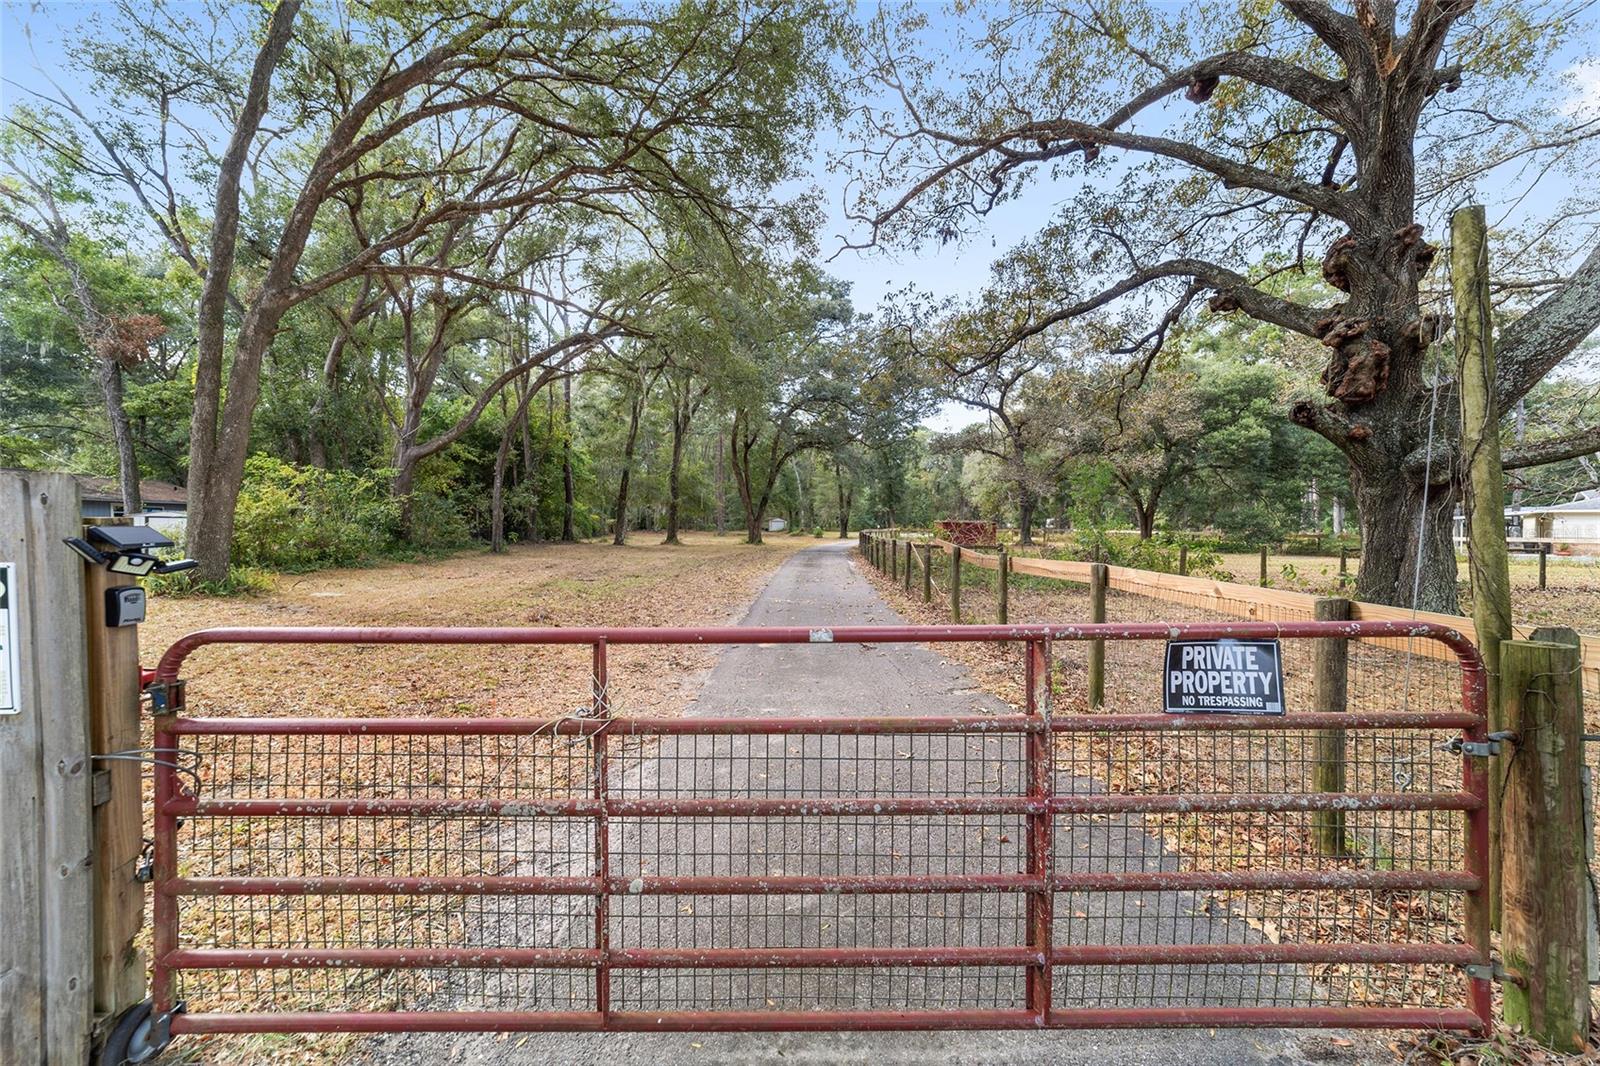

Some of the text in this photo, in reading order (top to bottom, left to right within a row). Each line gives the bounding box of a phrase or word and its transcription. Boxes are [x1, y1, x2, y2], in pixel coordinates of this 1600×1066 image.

[1182, 646, 1259, 670] PRIVATE
[1171, 671, 1272, 695] PROPERTY
[1182, 696, 1263, 708] NO TRESPASSING
